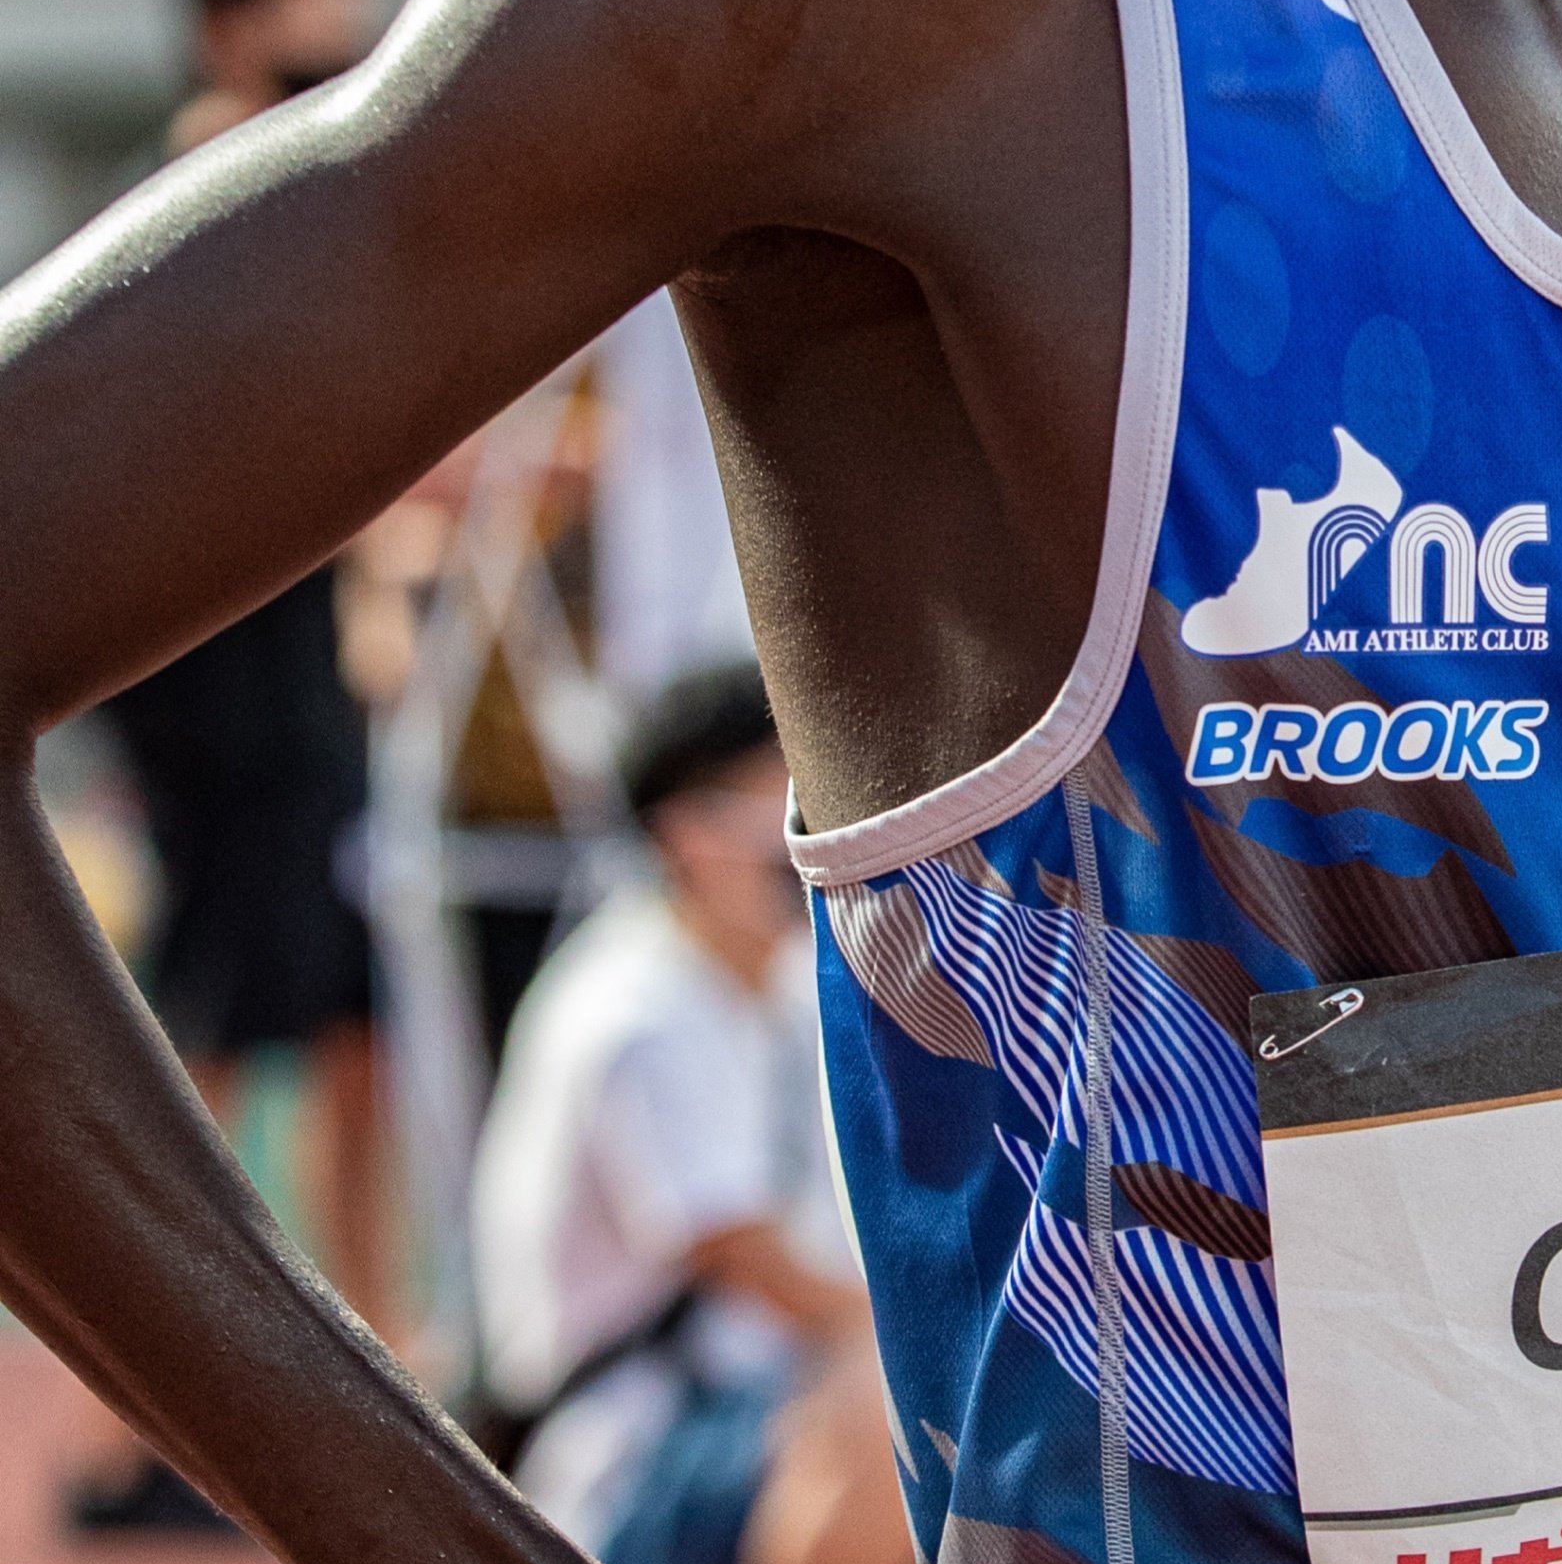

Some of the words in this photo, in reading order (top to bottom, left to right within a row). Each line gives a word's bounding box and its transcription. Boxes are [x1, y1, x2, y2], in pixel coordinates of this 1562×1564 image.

[1304, 630, 1359, 653] AMI
[1362, 628, 1478, 652] ATHLETE
[1481, 628, 1549, 652] CLUB
[1186, 700, 1549, 786] BROOKS
